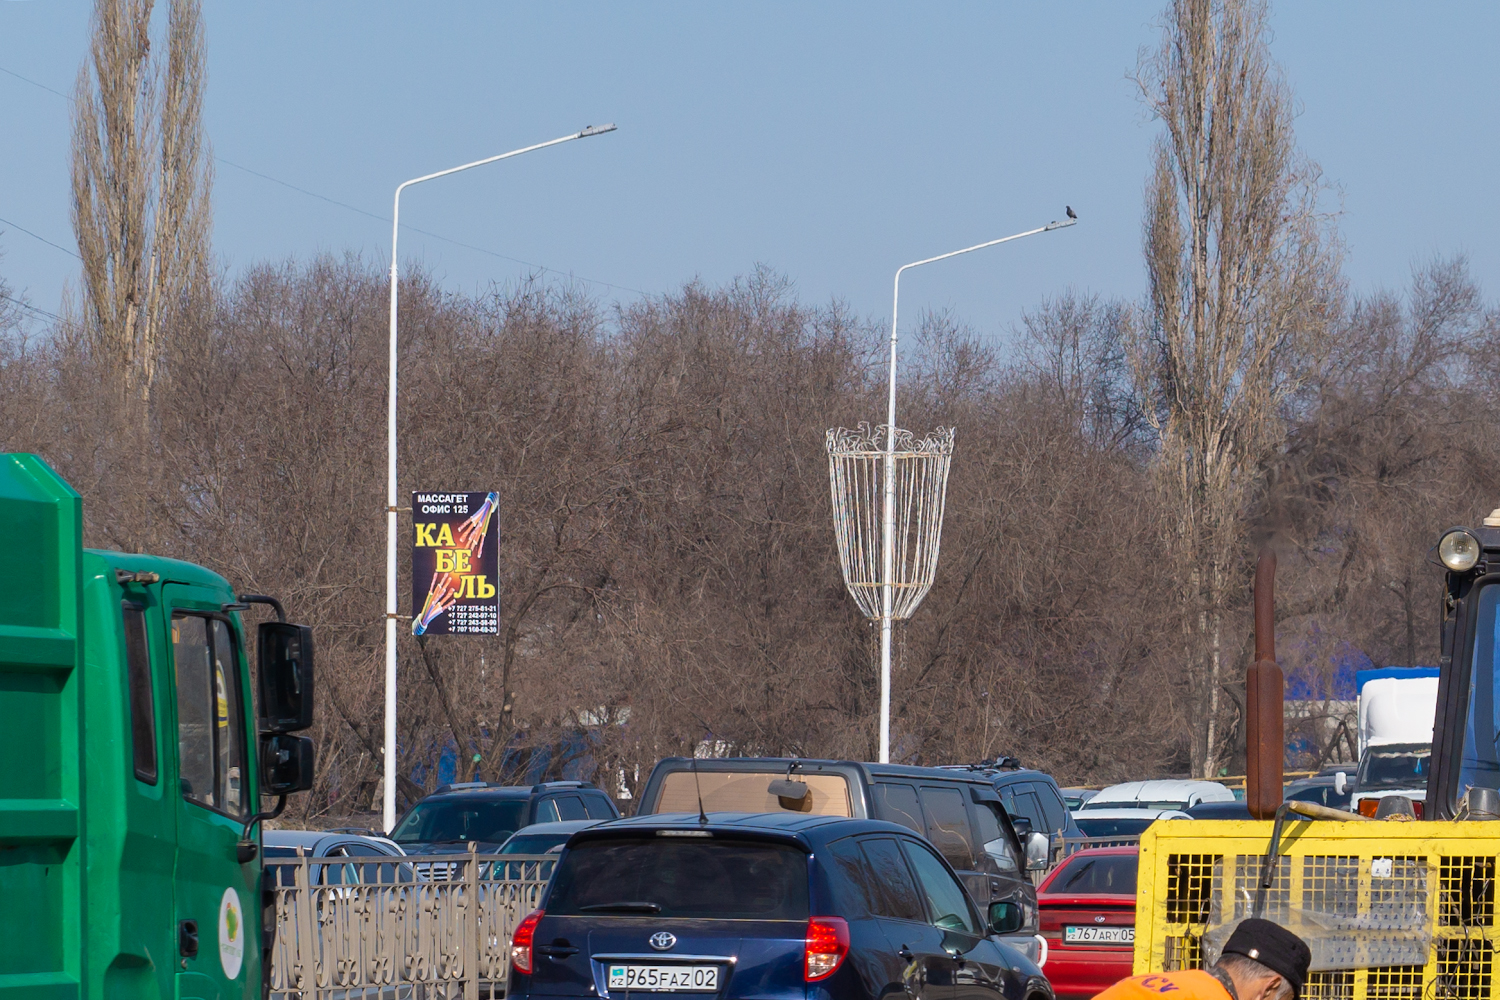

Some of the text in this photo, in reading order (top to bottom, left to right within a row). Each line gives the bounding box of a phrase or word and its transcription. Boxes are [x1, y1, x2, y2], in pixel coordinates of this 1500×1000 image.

[417, 494, 469, 503] МАССАГЕТ
[421, 505, 469, 514] ОФИС 125
[415, 523, 456, 547] КА
[435, 549, 472, 573] БЕ
[454, 575, 496, 599] ЛЬ
